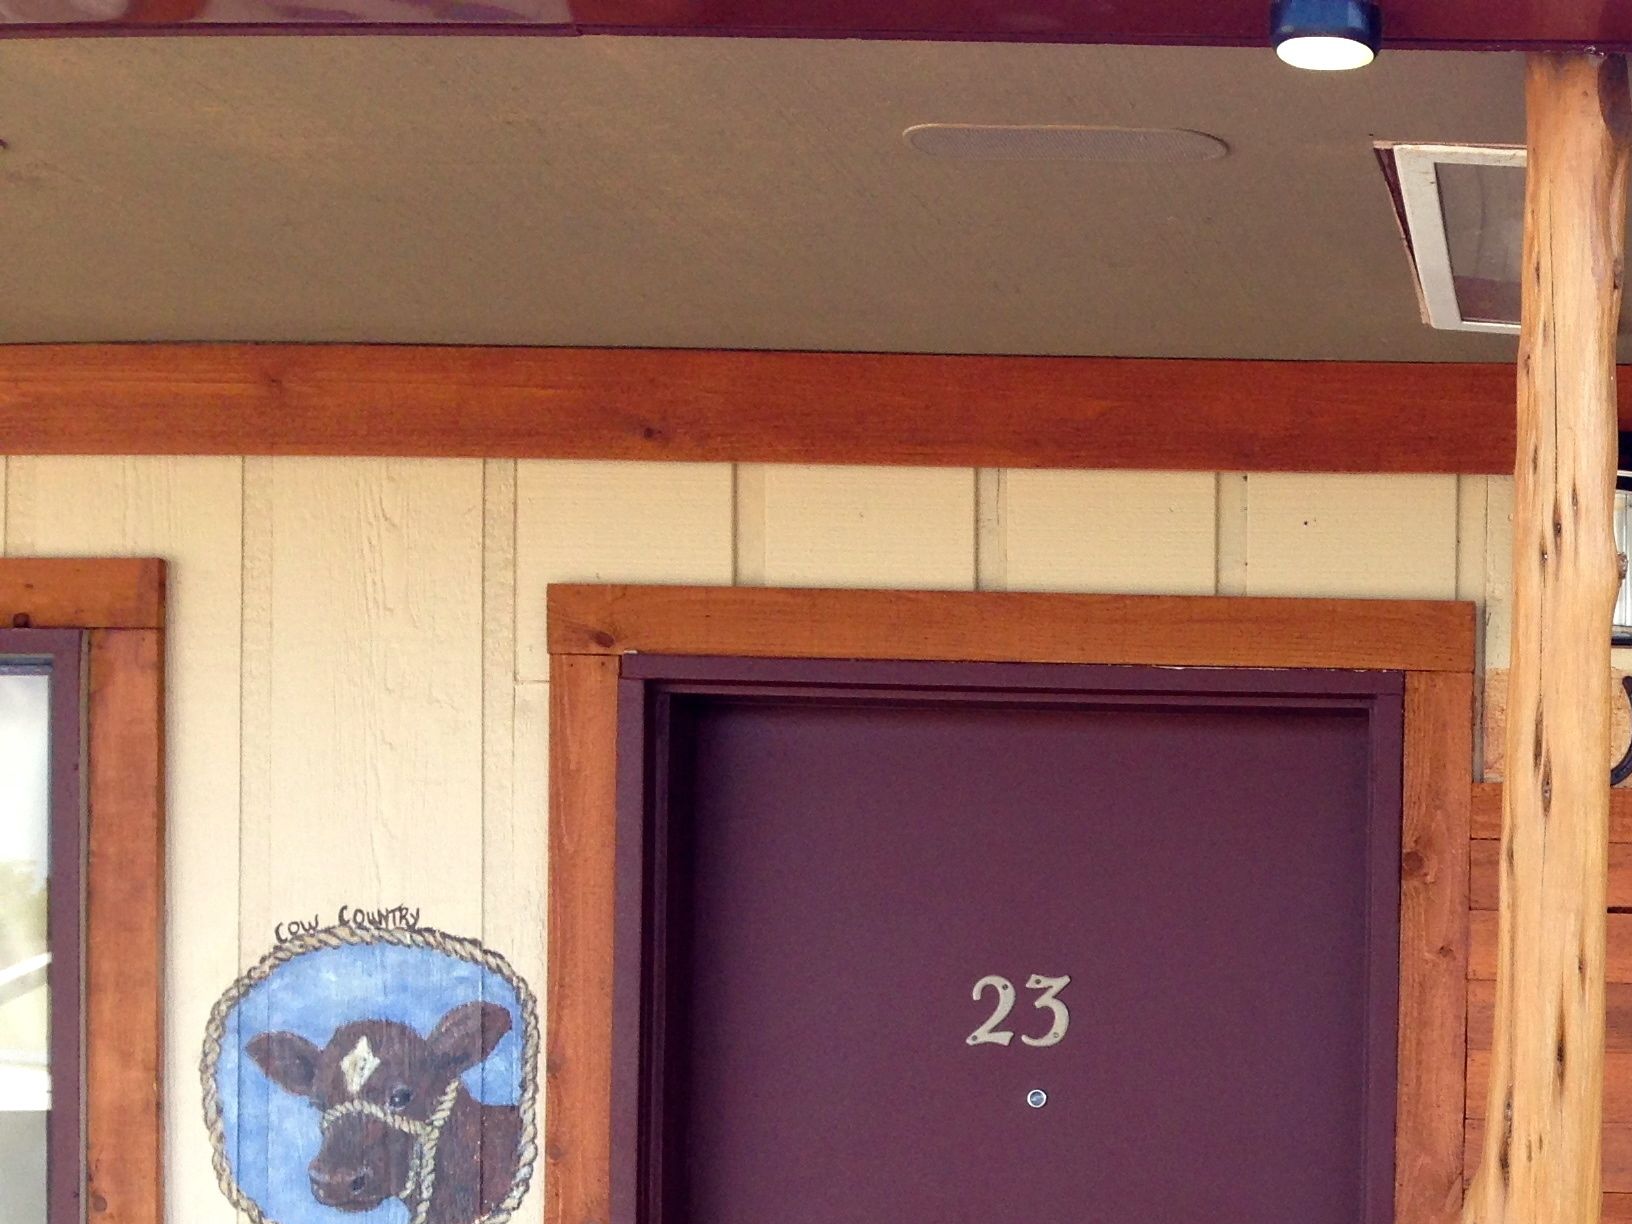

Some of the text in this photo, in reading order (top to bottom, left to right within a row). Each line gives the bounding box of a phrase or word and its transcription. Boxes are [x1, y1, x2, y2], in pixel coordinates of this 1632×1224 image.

[274, 903, 420, 944] COW COUNTRY
[966, 973, 1072, 1047] 23
